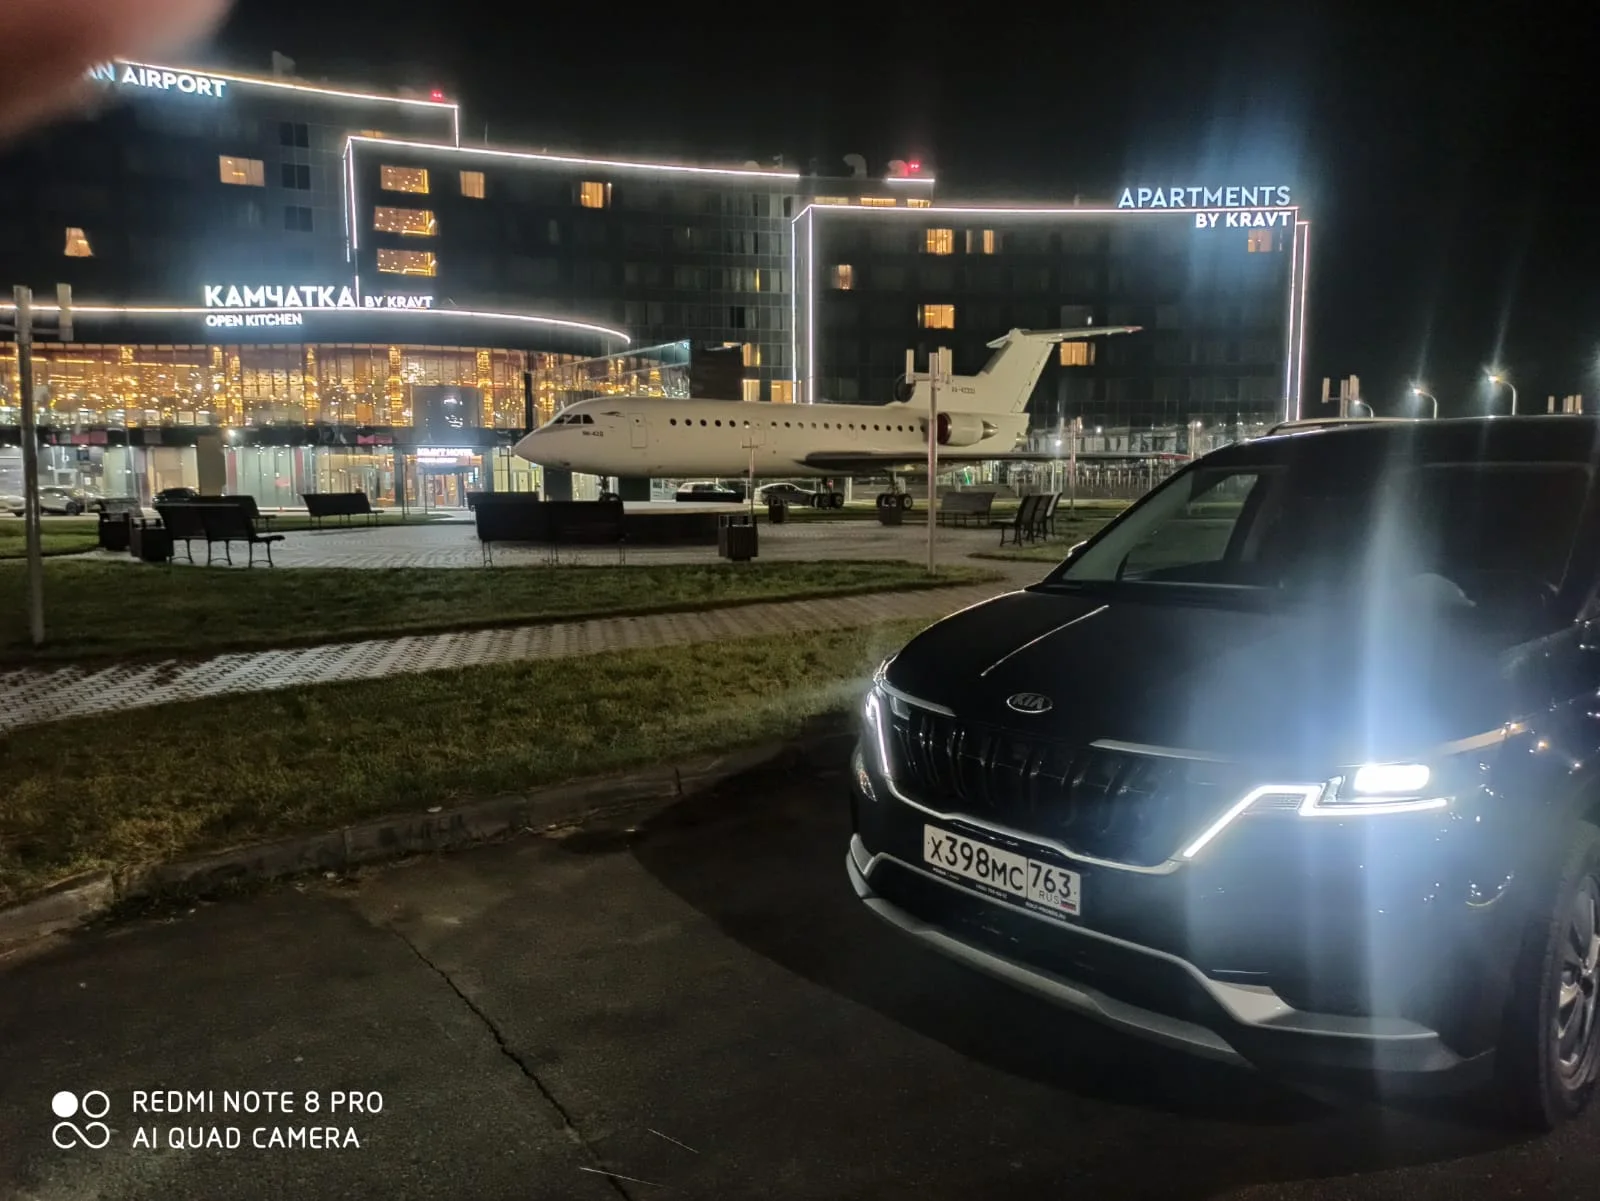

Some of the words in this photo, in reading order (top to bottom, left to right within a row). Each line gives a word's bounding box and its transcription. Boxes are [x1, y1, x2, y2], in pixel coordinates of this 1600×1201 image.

[122, 66, 226, 98] AIRPORT
[1118, 186, 1291, 208] APARTMENTS
[1195, 213, 1219, 229] BY
[1226, 212, 1291, 228] KRAVT
[204, 285, 354, 307] КАМЧАТКА
[365, 296, 382, 308] BY
[387, 296, 434, 309] KRAVT
[205, 314, 243, 327] OPEN
[246, 313, 303, 326] KITCHEN
[1012, 694, 1045, 710] KIA
[930, 836, 1025, 891] Х398МС
[1030, 862, 1071, 898] 763
[1038, 889, 1060, 905] RUS
